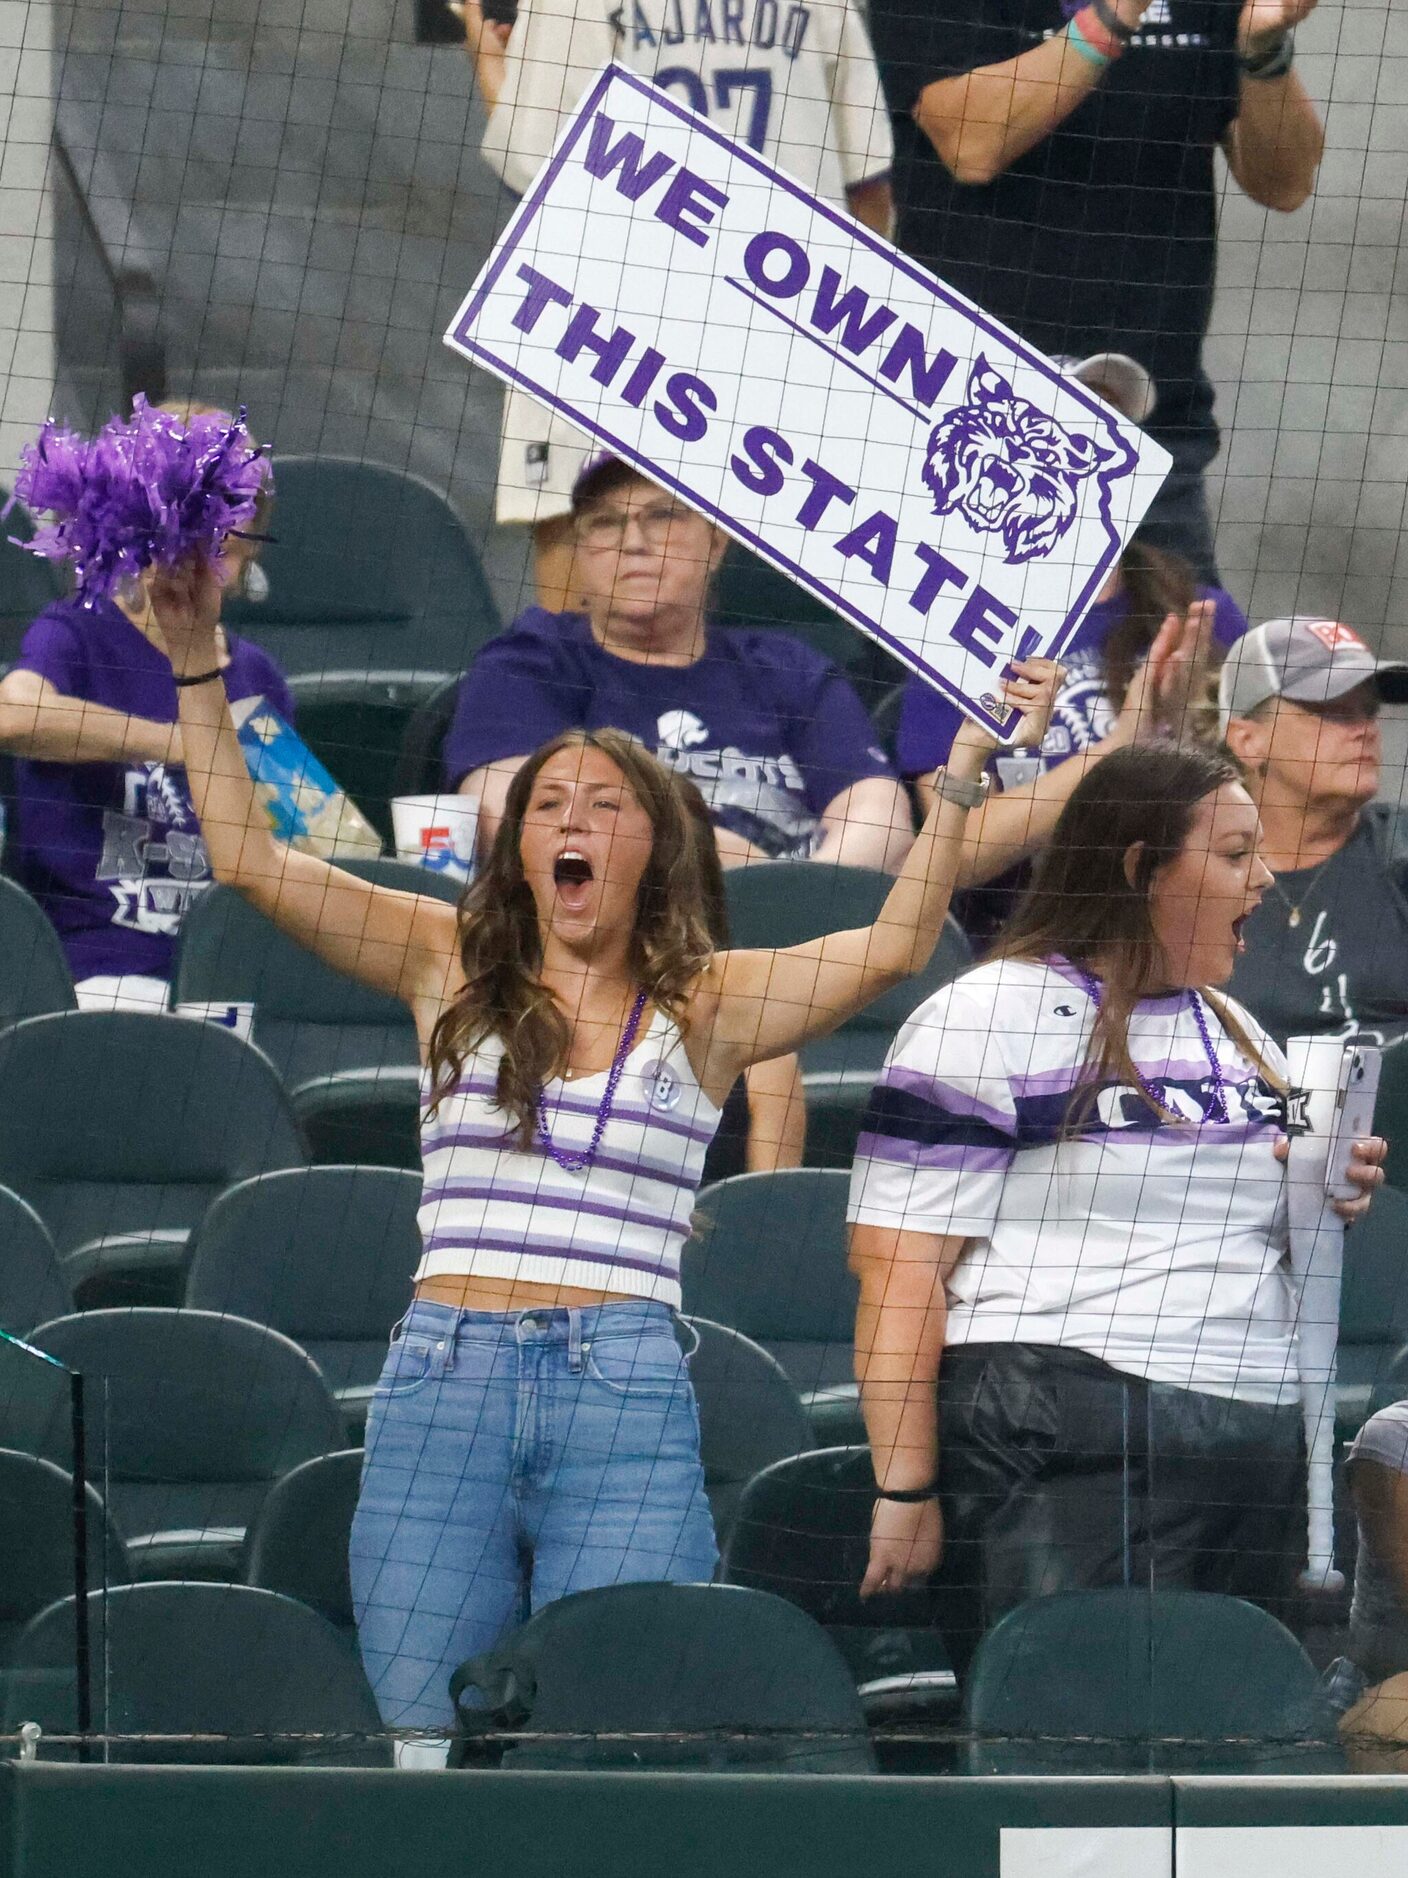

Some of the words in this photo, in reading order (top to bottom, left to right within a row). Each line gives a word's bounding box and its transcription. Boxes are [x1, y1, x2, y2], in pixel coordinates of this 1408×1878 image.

[510, 262, 718, 443] THIS
[583, 110, 731, 249] WE
[744, 230, 959, 409] OWN
